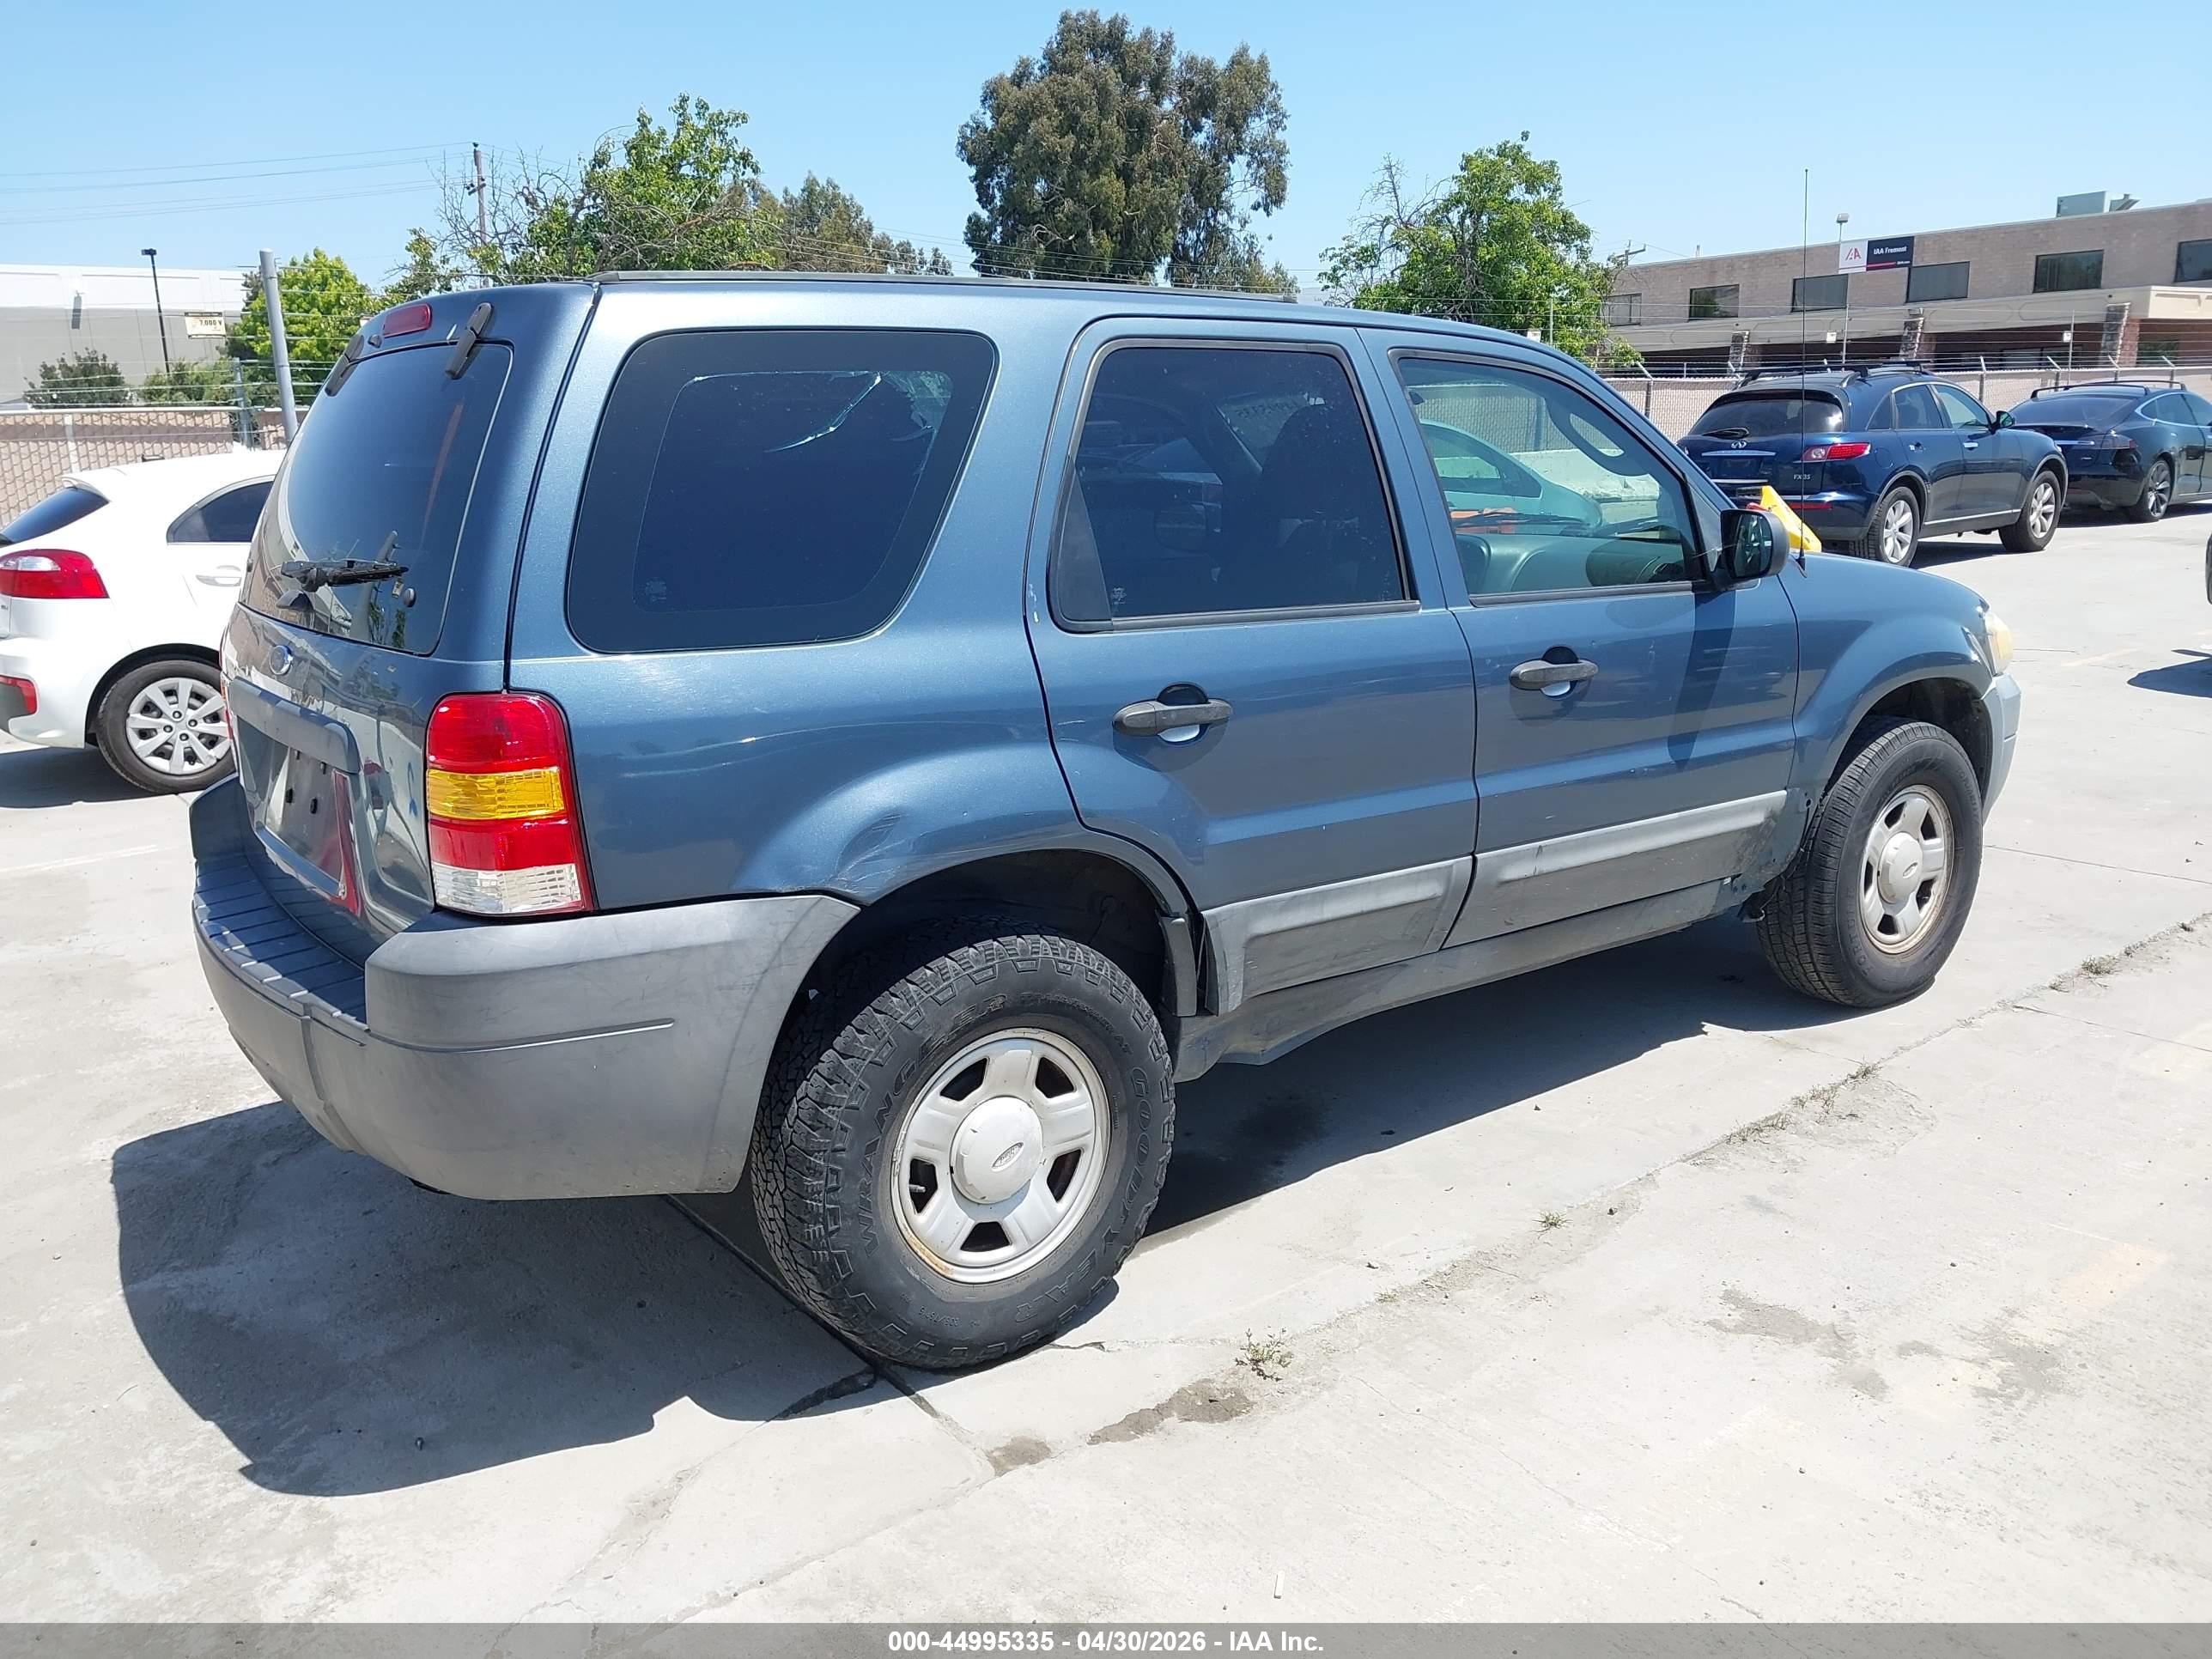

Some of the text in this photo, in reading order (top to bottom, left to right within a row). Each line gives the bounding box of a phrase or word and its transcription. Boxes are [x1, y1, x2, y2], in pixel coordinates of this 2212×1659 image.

[1885, 246, 1907, 254] Fremont
[859, 994, 1007, 1257] WRANGLER
[1014, 1067, 1152, 1322] GOODYEAR
